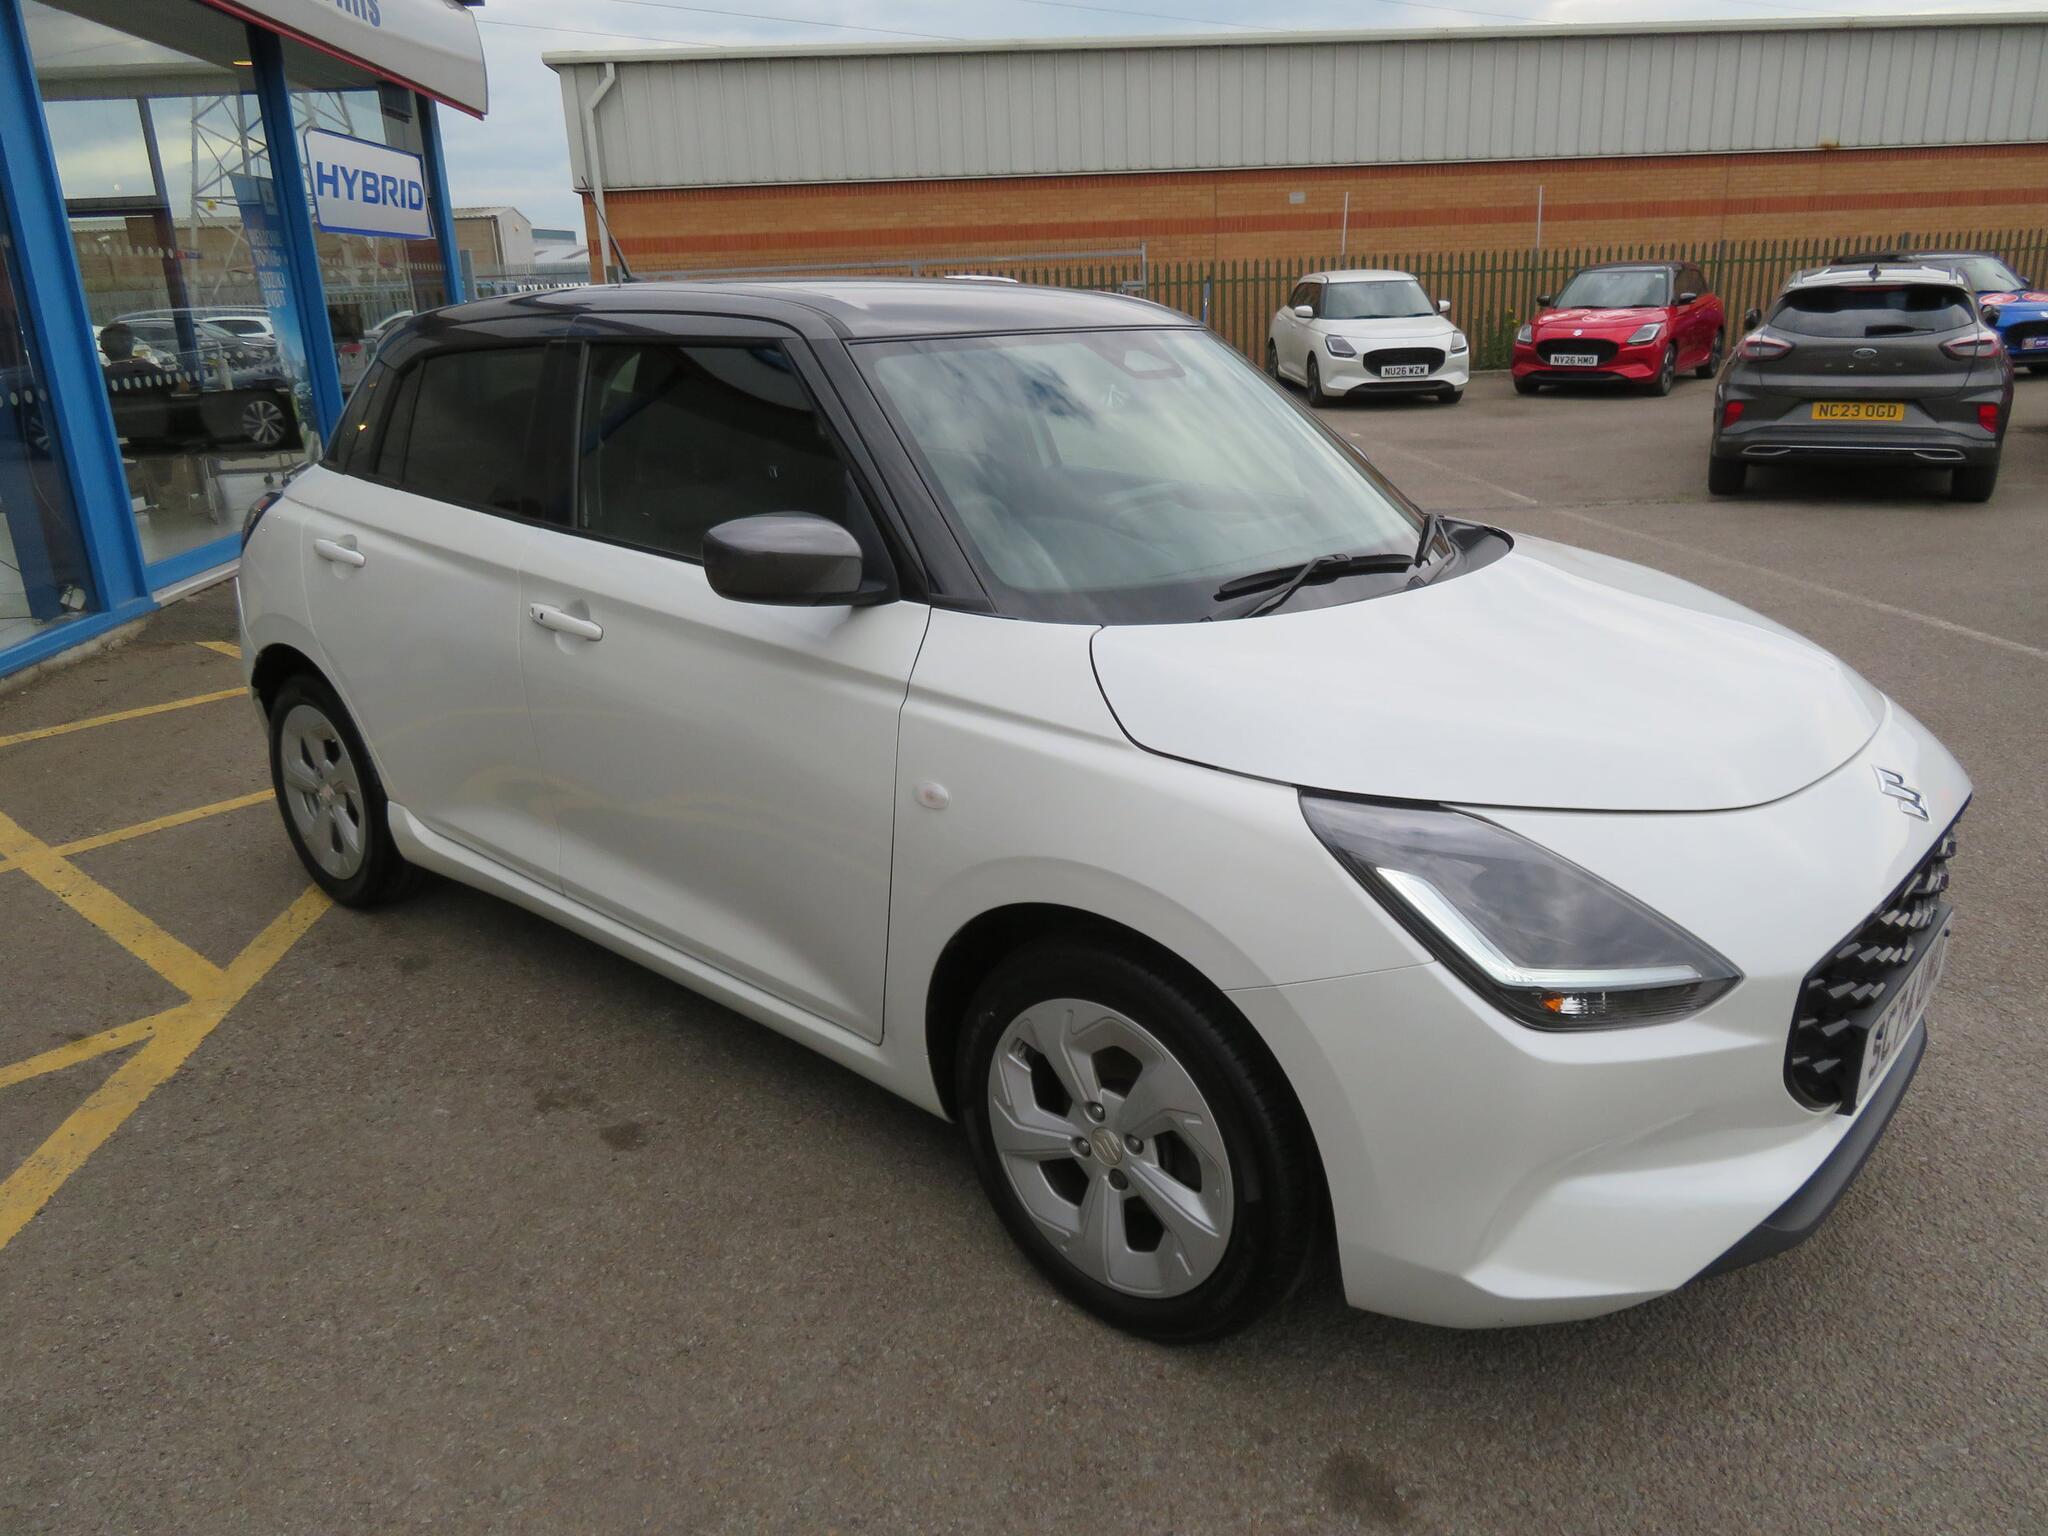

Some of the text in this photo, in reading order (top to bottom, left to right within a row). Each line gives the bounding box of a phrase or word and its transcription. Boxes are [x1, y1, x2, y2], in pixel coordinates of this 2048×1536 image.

[316, 161, 424, 211] HYBRID
[1384, 366, 1407, 376] NU26
[1819, 404, 1897, 418] NC23 OGD
